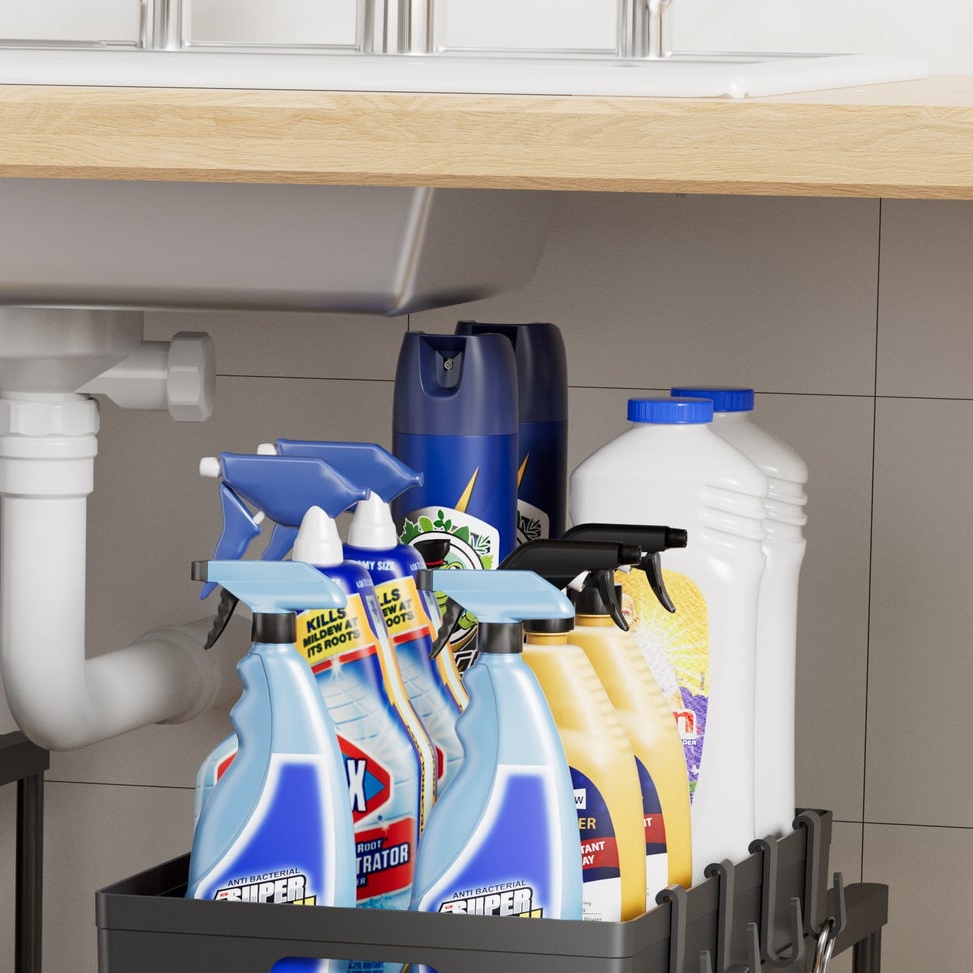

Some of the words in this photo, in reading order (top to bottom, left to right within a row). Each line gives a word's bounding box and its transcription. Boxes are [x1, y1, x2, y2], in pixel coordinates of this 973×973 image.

[377, 561, 396, 570] SIZE
[399, 599, 412, 612] AT
[307, 607, 347, 633] KILLS
[303, 623, 342, 648] MILDEW
[345, 616, 358, 630] AT
[307, 643, 323, 658] ITS
[324, 629, 361, 648] ROOTS
[357, 840, 382, 853] ROOT
[228, 878, 247, 887] ANTI
[250, 868, 300, 882] BACTERIAL
[453, 889, 473, 899] ANTI
[475, 880, 527, 895] BACTERIAL
